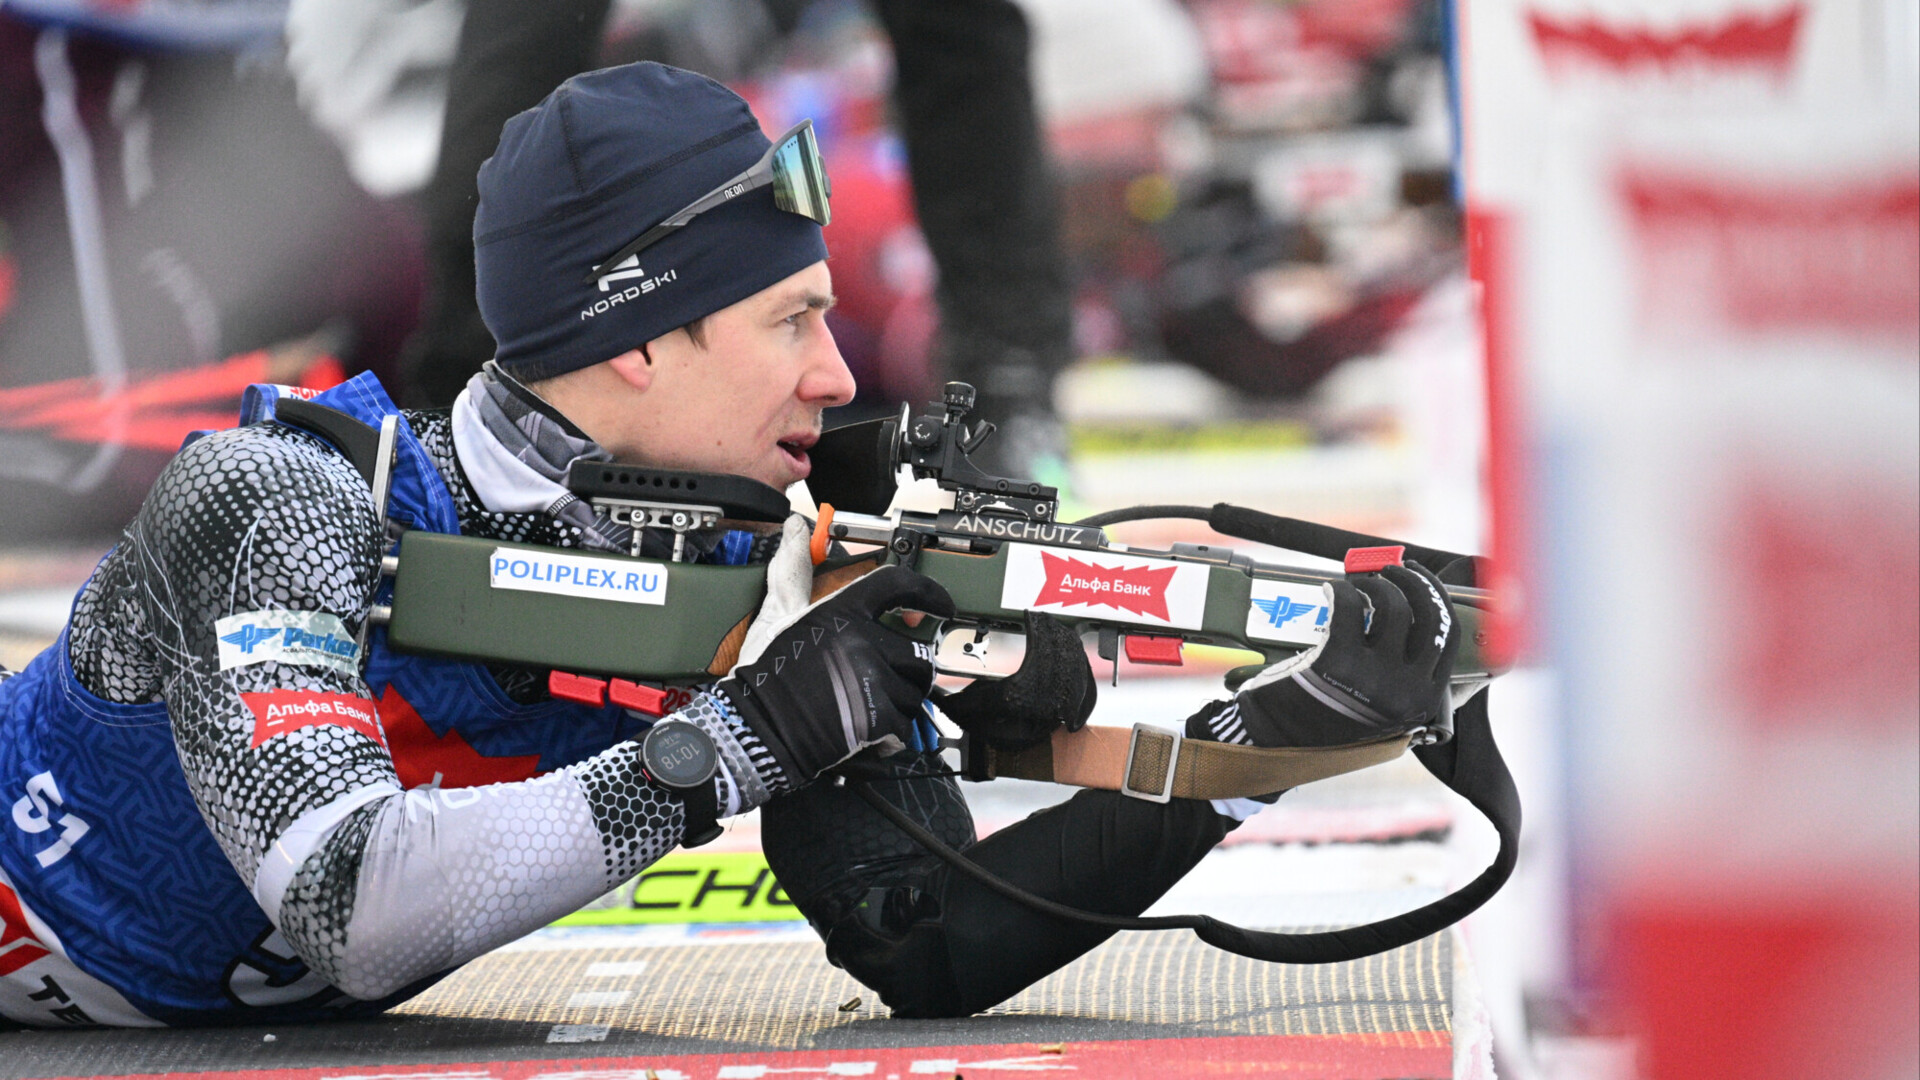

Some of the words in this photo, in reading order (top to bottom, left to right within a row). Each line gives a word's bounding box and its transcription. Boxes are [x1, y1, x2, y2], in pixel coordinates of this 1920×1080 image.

[581, 269, 678, 321] NORDSKI
[494, 558, 659, 593] POLIPLEX.RU
[1059, 573, 1110, 593] Альфа
[1113, 579, 1152, 596] Банк
[862, 677, 876, 709] Legend
[265, 700, 333, 727] Альфа
[333, 701, 374, 727] Банк
[660, 743, 700, 770] 10:18
